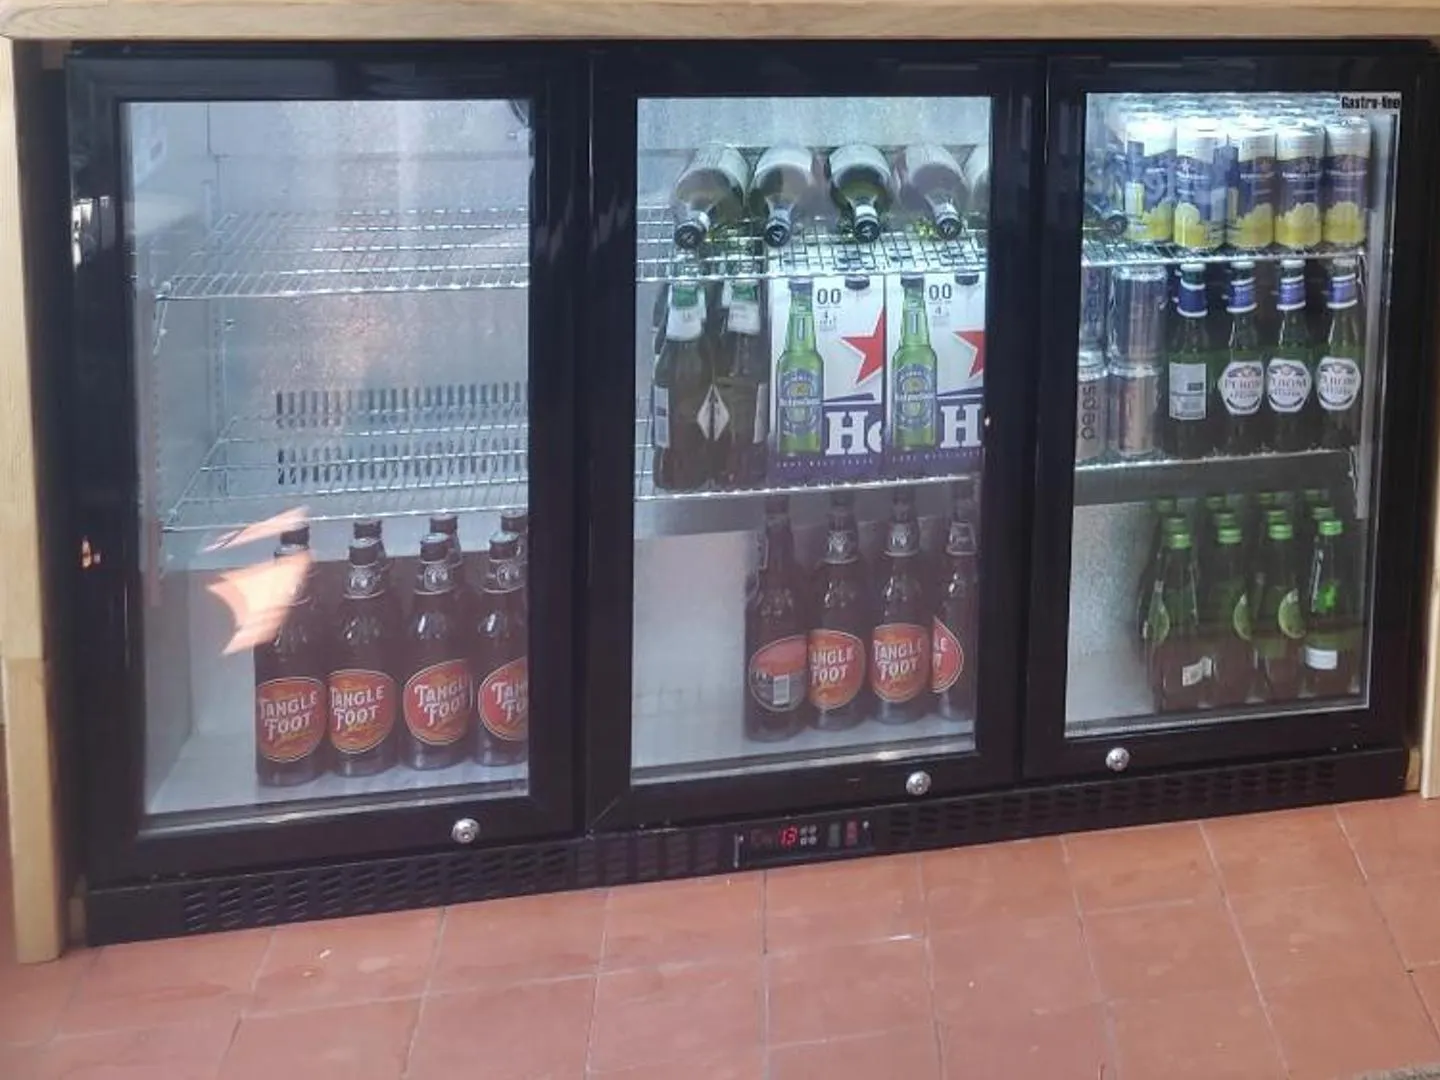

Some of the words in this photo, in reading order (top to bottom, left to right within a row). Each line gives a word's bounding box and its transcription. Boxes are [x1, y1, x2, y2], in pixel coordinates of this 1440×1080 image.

[1080, 385, 1098, 440] peps
[811, 644, 856, 666] ANGLE
[259, 690, 318, 721] TANGLE
[330, 684, 385, 709] TANGLE
[264, 712, 312, 741] FOOT
[334, 705, 379, 732] FOOT
